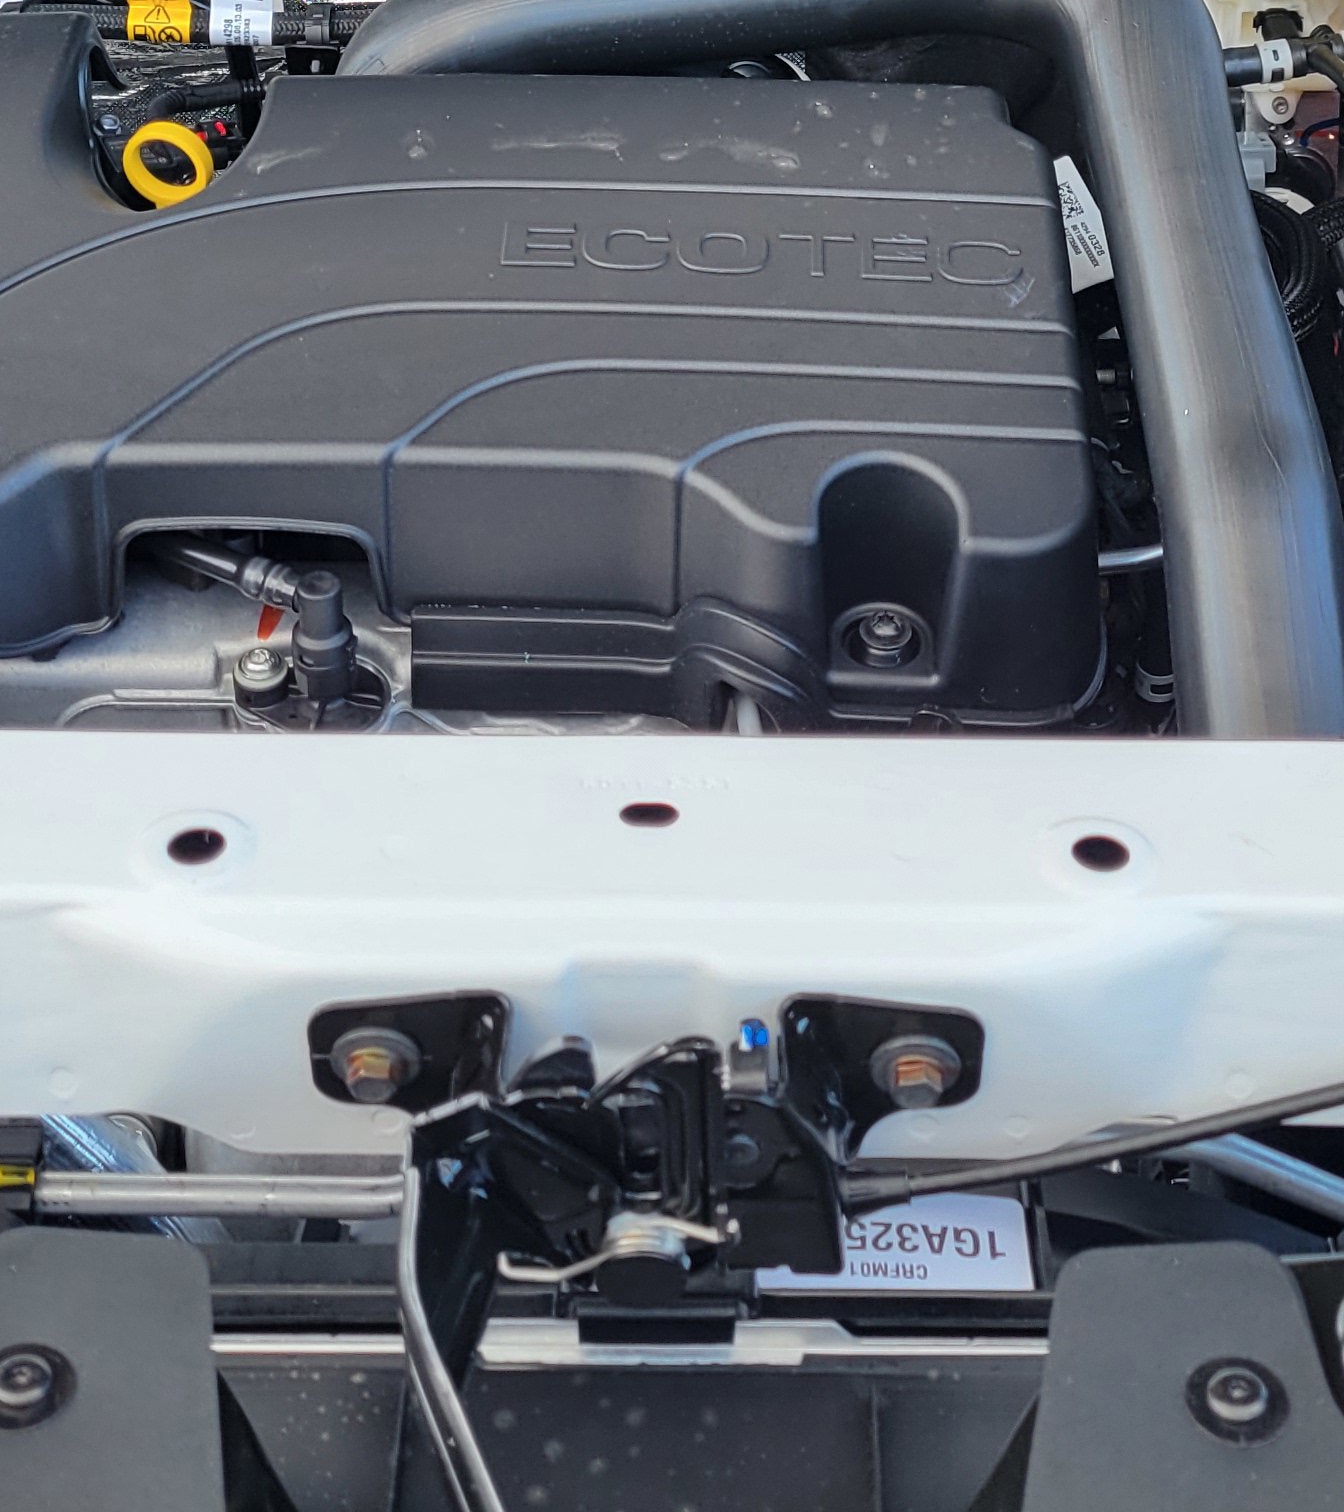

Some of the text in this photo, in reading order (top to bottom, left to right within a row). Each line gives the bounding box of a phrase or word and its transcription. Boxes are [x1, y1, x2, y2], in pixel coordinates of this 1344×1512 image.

[500, 220, 1023, 286] ECOTEC
[845, 1221, 1007, 1260] 1GA325
[849, 1261, 928, 1281] CRFM01
